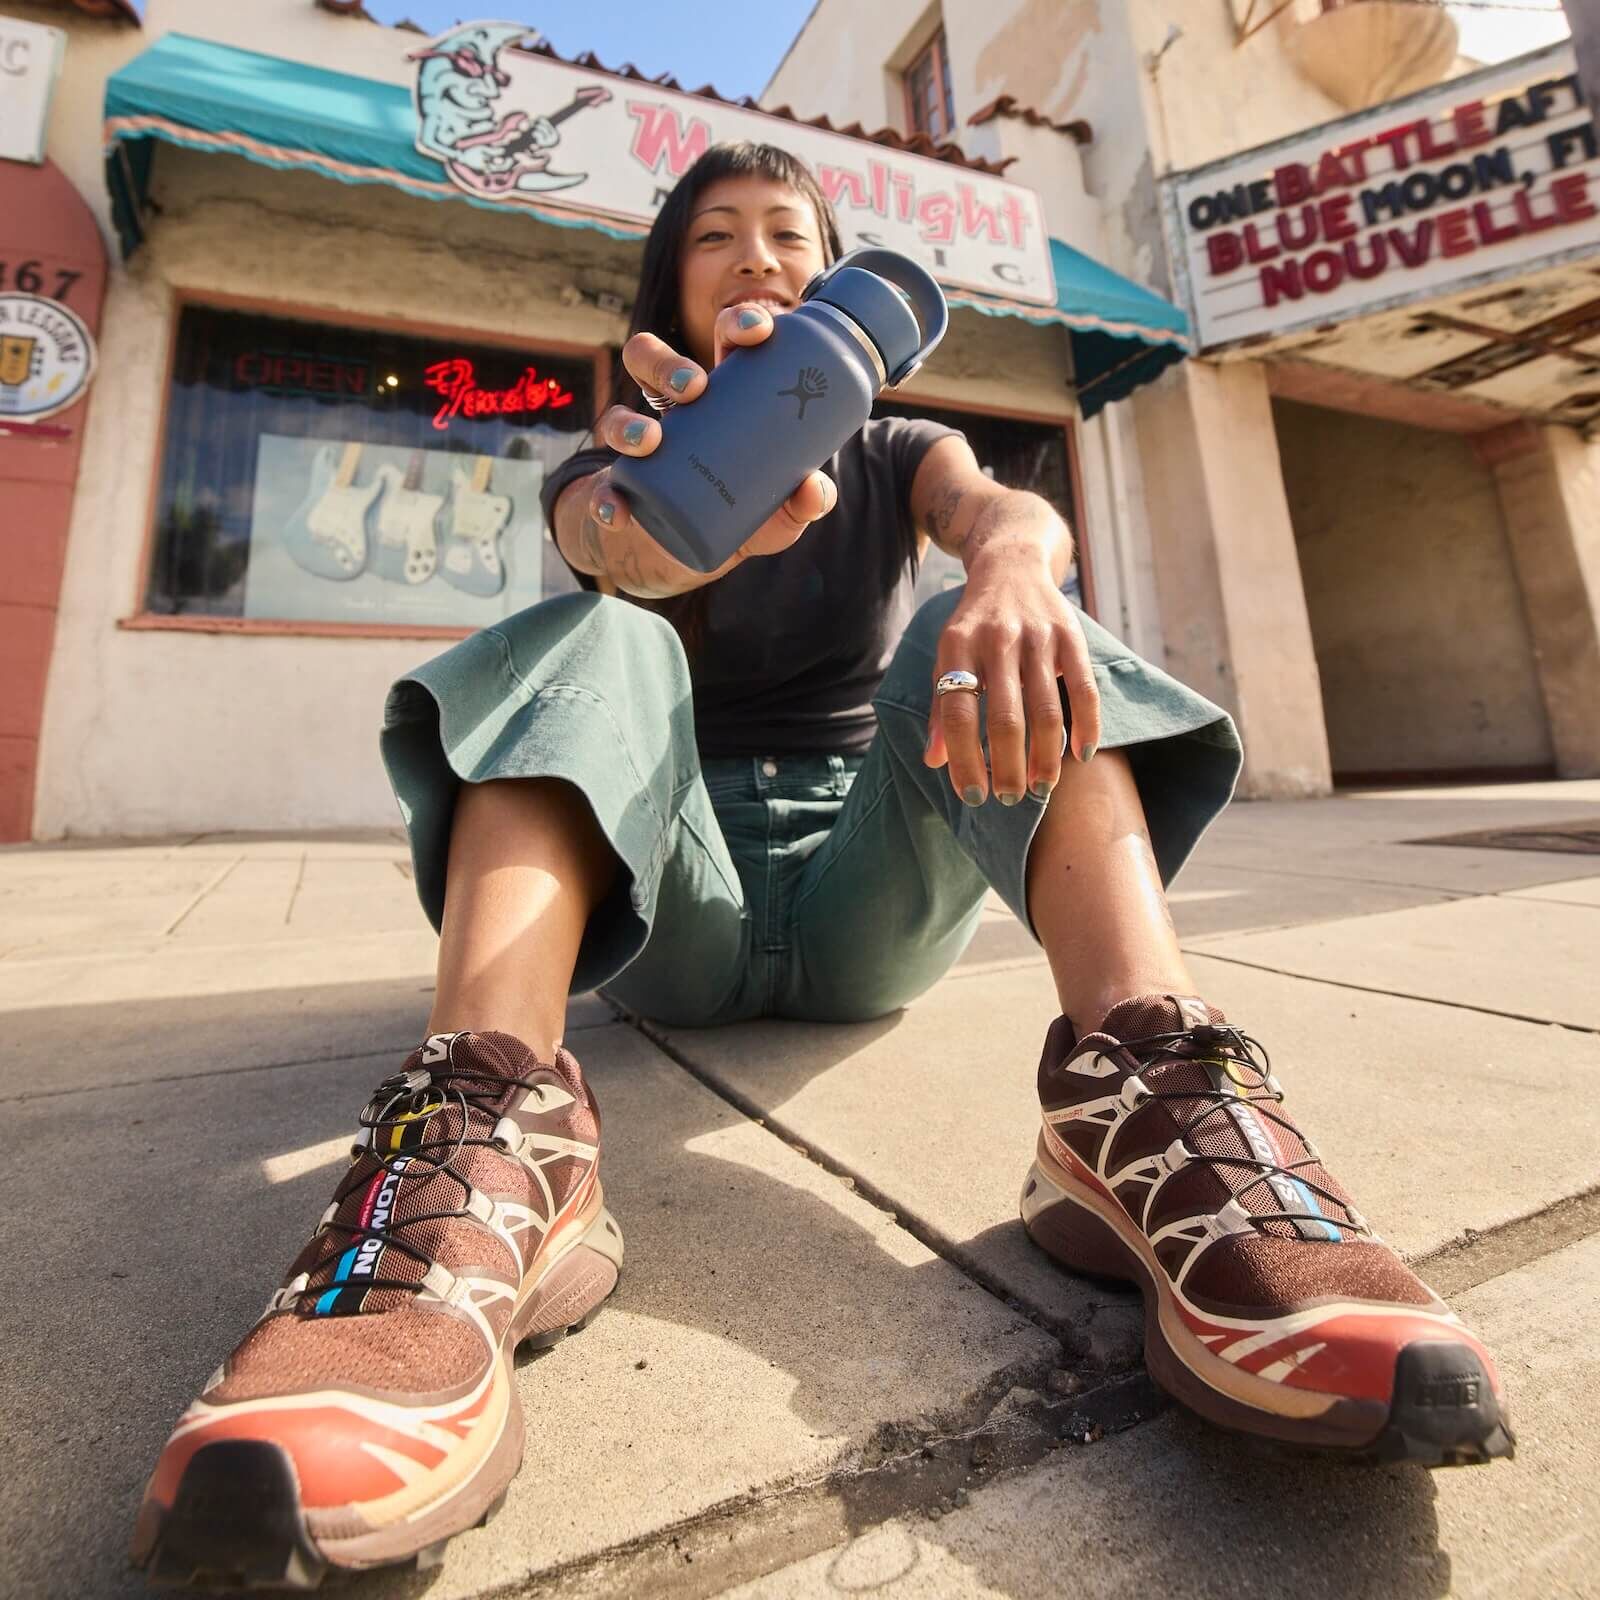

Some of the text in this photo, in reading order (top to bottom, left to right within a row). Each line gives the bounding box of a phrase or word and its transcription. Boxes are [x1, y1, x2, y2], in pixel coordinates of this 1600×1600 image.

[625, 99, 1030, 249] Mnlight
[1189, 179, 1275, 230] ONE
[1275, 100, 1494, 208] BATTLE
[1206, 193, 1358, 276] BLUE
[1360, 147, 1534, 225] MOON,
[0, 260, 83, 302] 67
[1260, 172, 1598, 308] NOUVELLE
[234, 353, 367, 392] OPEN
